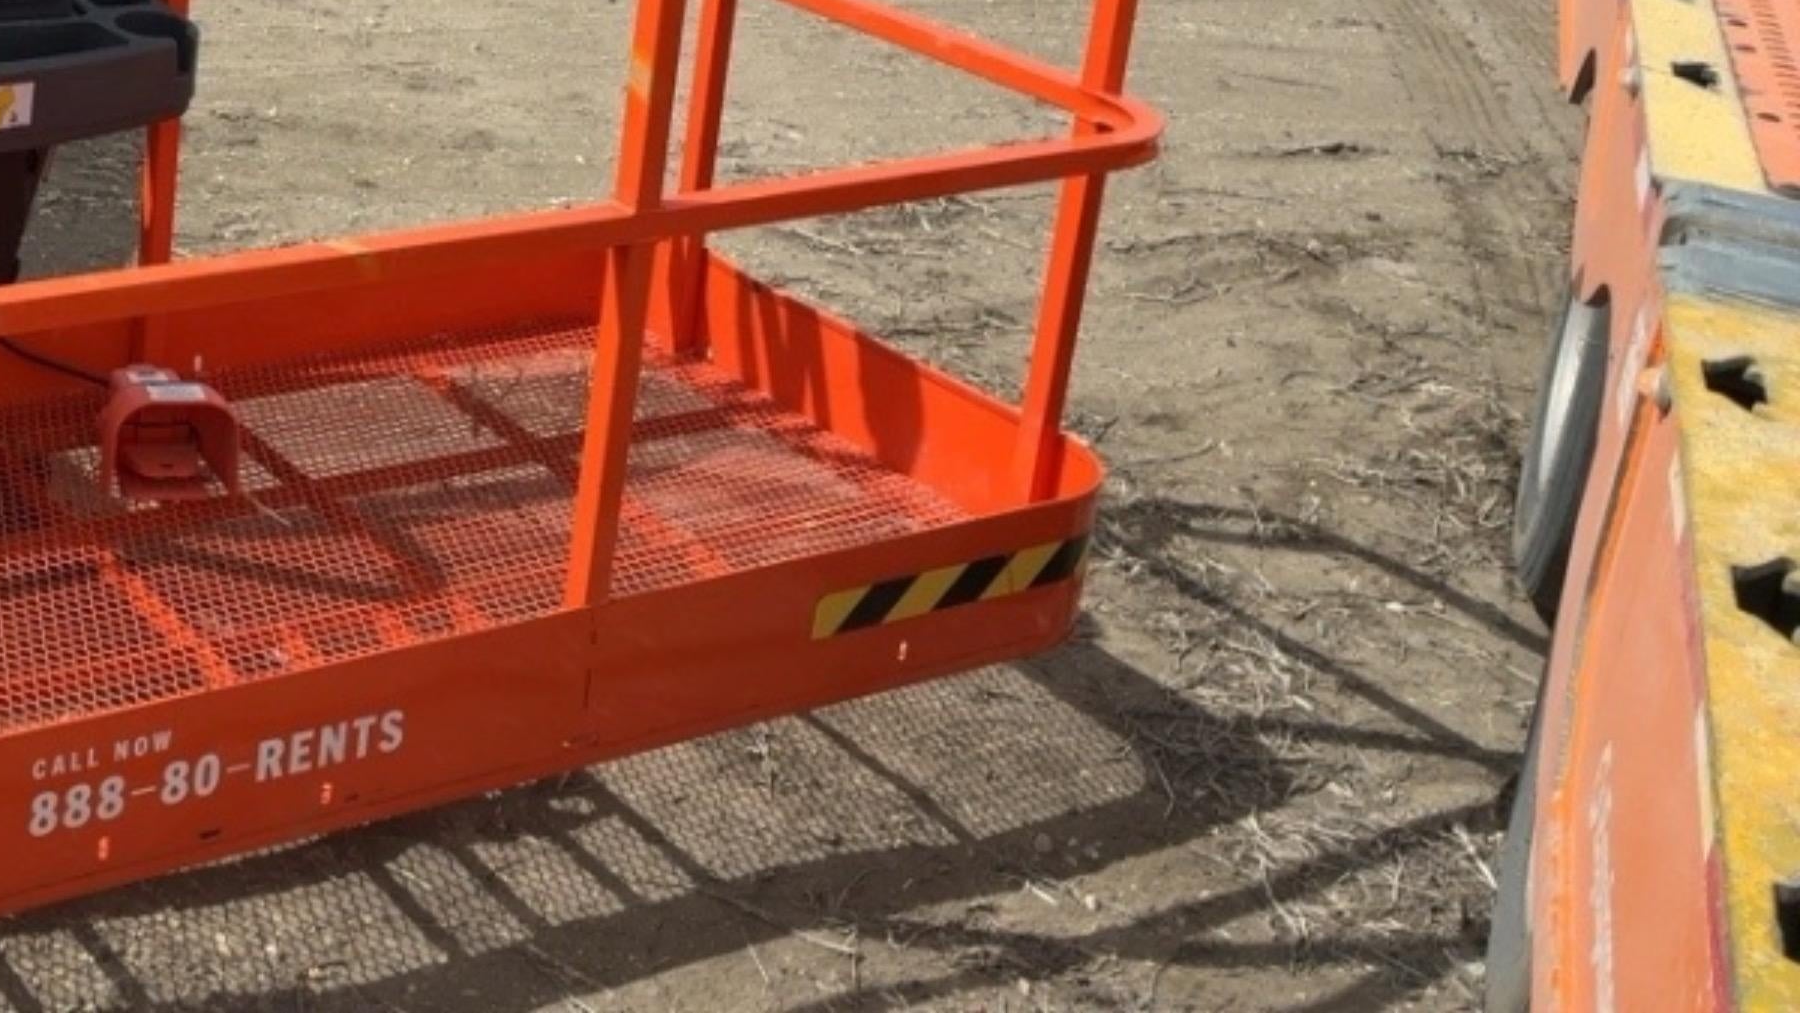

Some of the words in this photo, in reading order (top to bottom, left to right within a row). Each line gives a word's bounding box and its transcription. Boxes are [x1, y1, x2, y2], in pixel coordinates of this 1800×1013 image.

[28, 709, 405, 837] 888-80-RENTS
[31, 747, 100, 780] CALL
[113, 730, 173, 761] NOW
